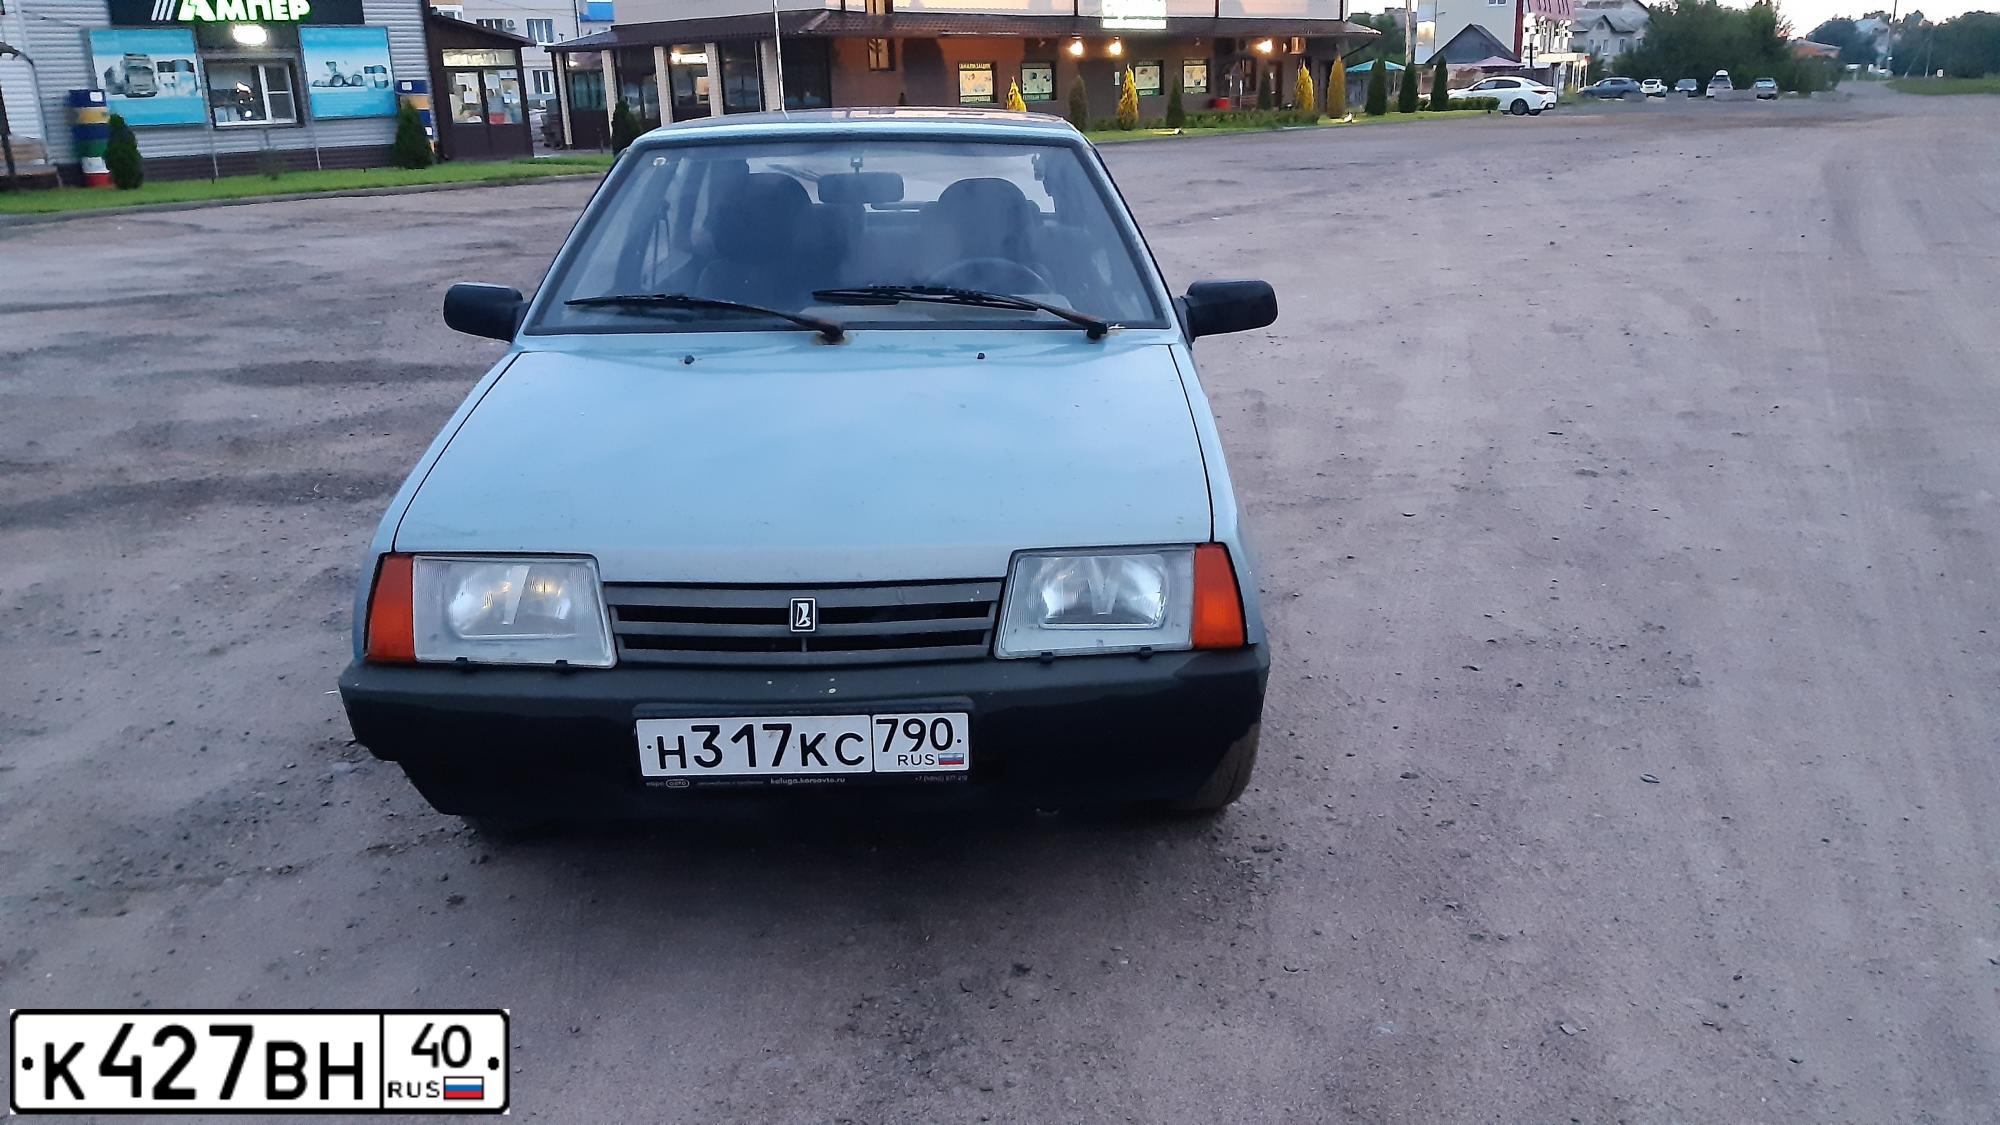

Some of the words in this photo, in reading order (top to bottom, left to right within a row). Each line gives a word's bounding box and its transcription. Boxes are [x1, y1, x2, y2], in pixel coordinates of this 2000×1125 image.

[656, 723, 866, 770] Н317КС
[875, 717, 953, 753] 790
[897, 752, 935, 767] RUS
